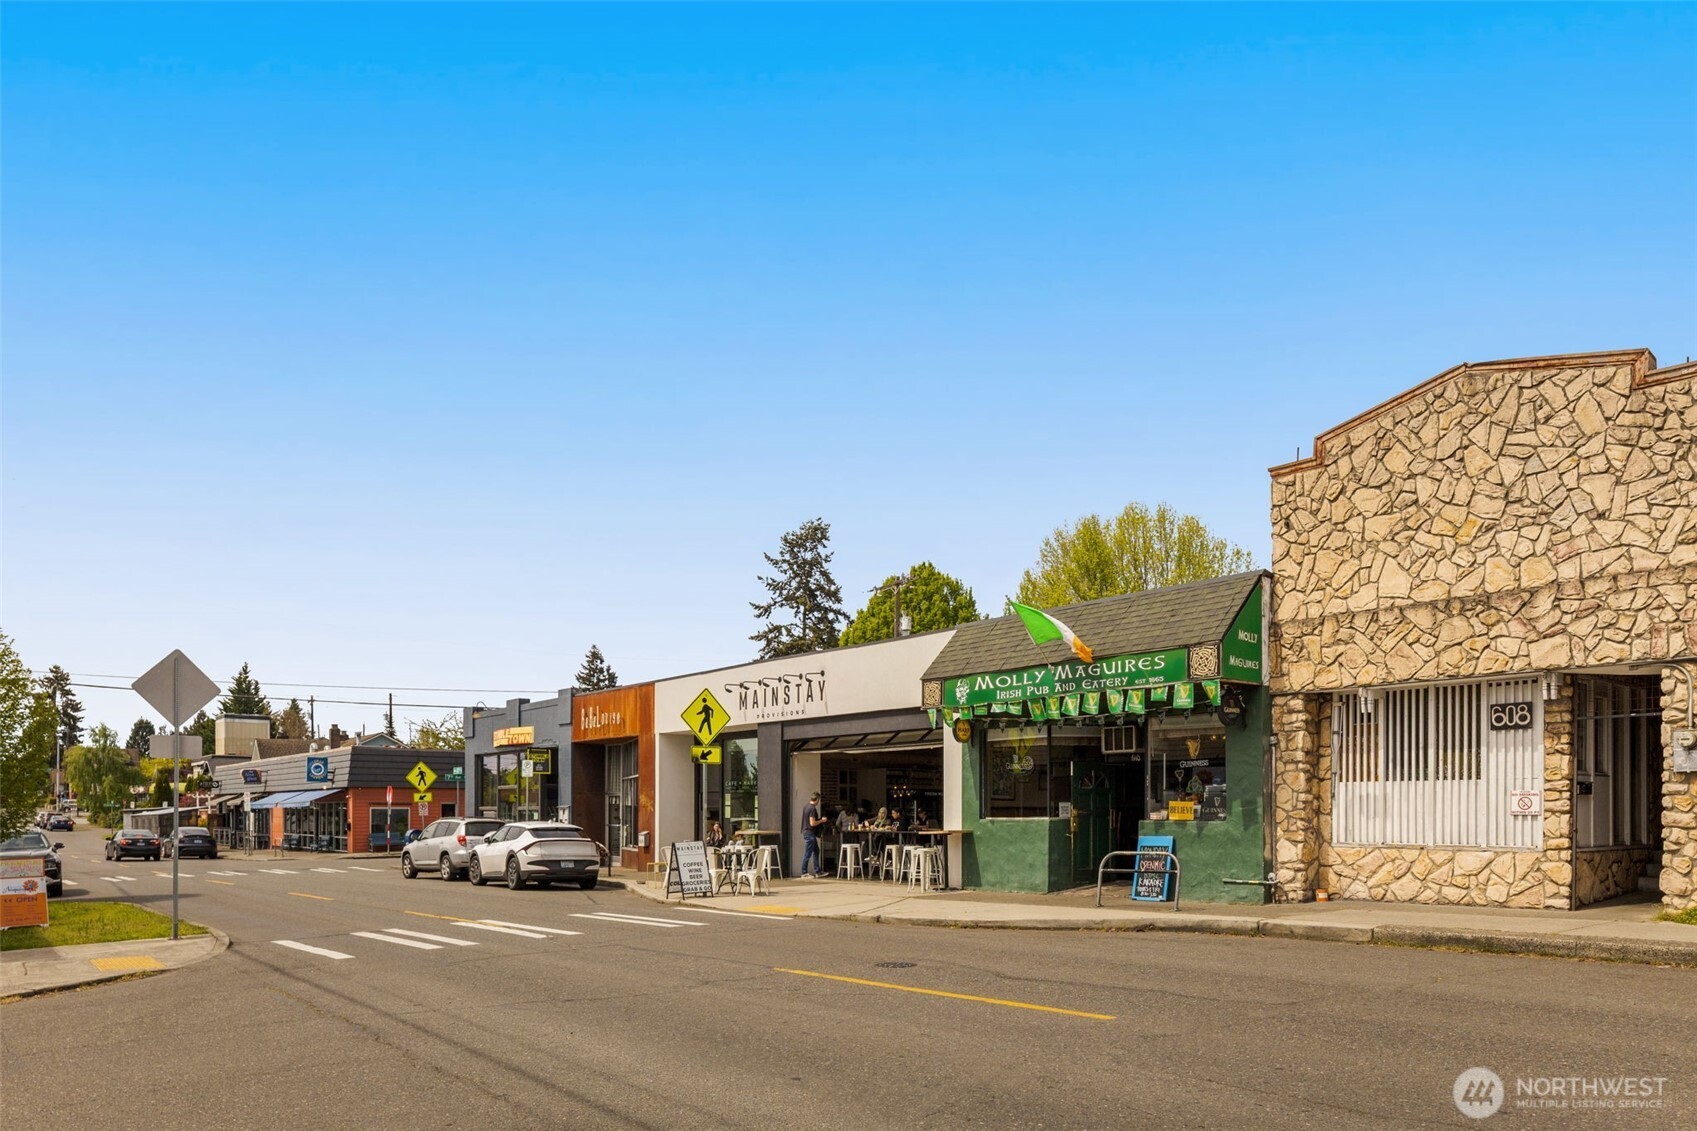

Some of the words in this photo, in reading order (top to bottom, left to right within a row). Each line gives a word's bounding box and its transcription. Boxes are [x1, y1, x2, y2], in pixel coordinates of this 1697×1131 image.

[1238, 629, 1258, 643] MOLLY
[1229, 655, 1259, 669] MAGUIRES
[974, 670, 1046, 691] MOLLY
[1053, 655, 1166, 680] MAGUIRES
[997, 688, 1021, 700] IRISH
[1027, 685, 1049, 695] PUB
[1055, 683, 1076, 693] AND
[1082, 676, 1129, 690] EATERY
[739, 680, 826, 711] MAINSTAY
[756, 709, 805, 719] PROVISIONS
[1491, 704, 1531, 727] 608
[1180, 760, 1209, 768] GUINNESS
[1170, 805, 1194, 815] BELIEVE
[16, 896, 38, 904] OPEN
